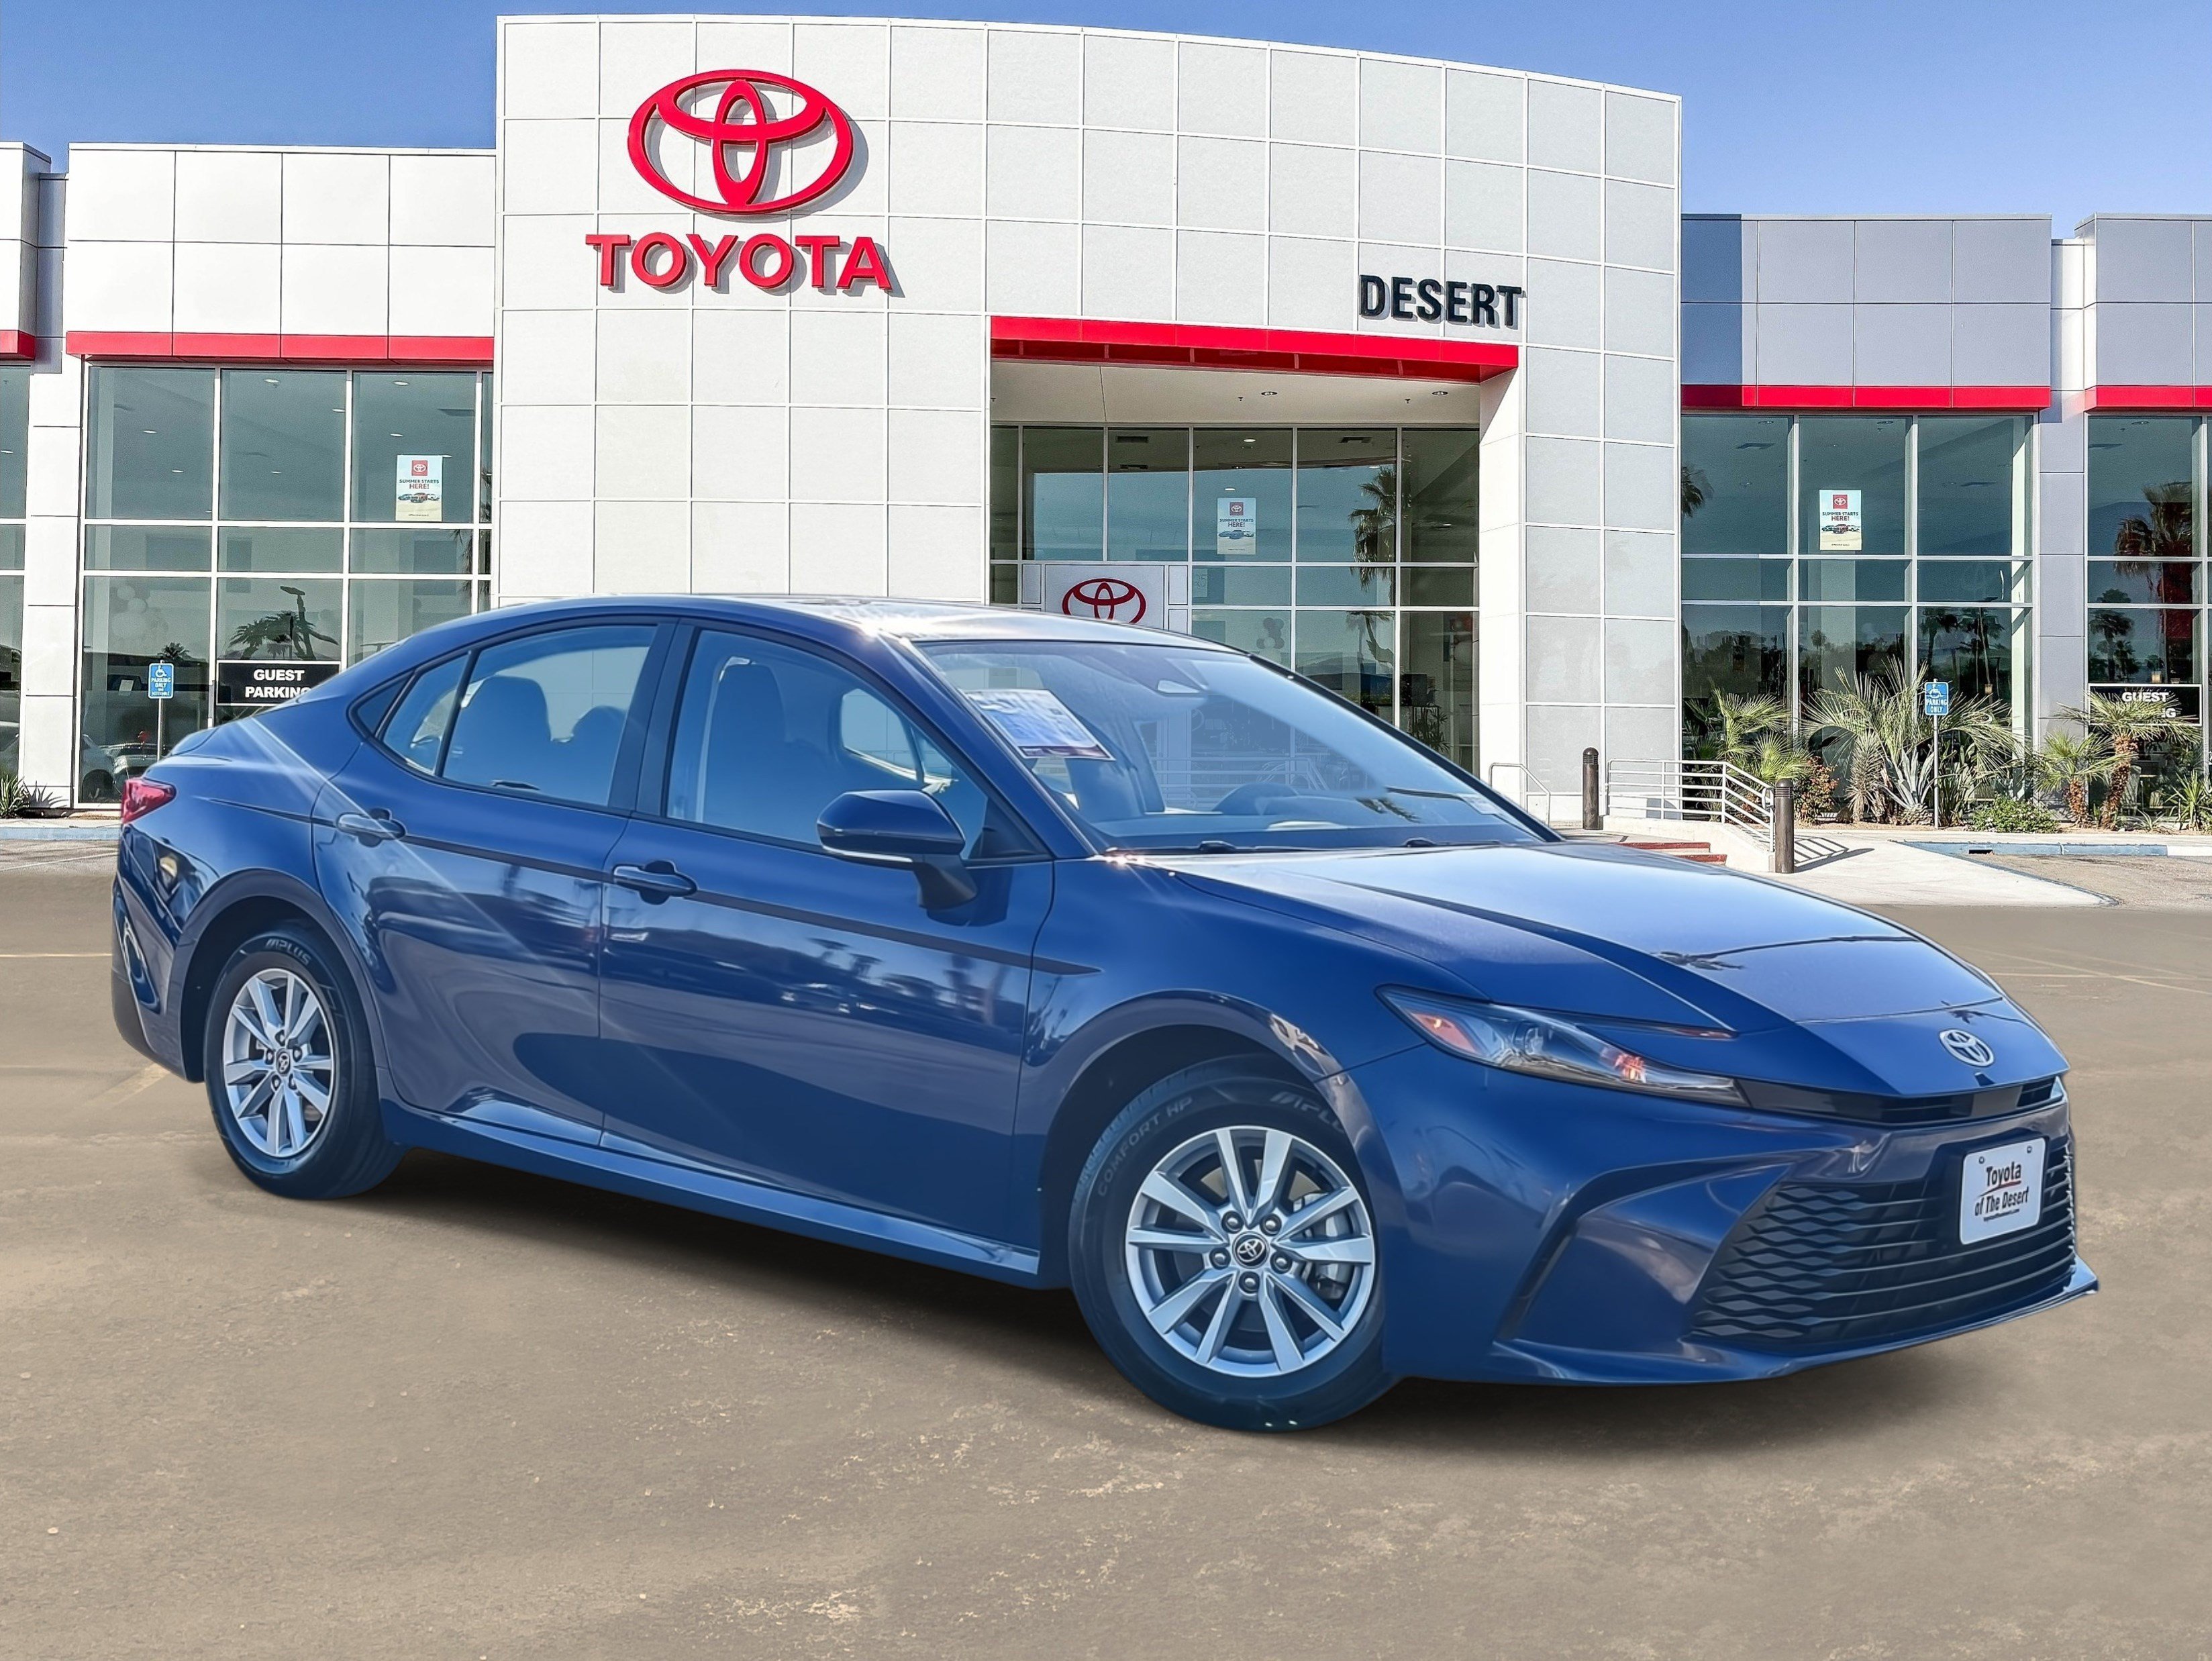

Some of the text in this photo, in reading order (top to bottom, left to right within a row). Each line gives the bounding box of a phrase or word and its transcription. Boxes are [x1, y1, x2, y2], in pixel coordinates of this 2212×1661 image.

[585, 232, 893, 291] TOYOTA
[1359, 274, 1522, 327] DESERT
[253, 668, 305, 681] GUEST
[1926, 698, 1948, 706] PARKING
[2121, 691, 2169, 702] GUEST
[1098, 1096, 1193, 1197] COMFORT HP
[1986, 1161, 2022, 1187] Toyota
[1974, 1197, 1984, 1216] of
[1985, 1193, 2000, 1214] The
[2002, 1187, 2029, 1209] Desert
